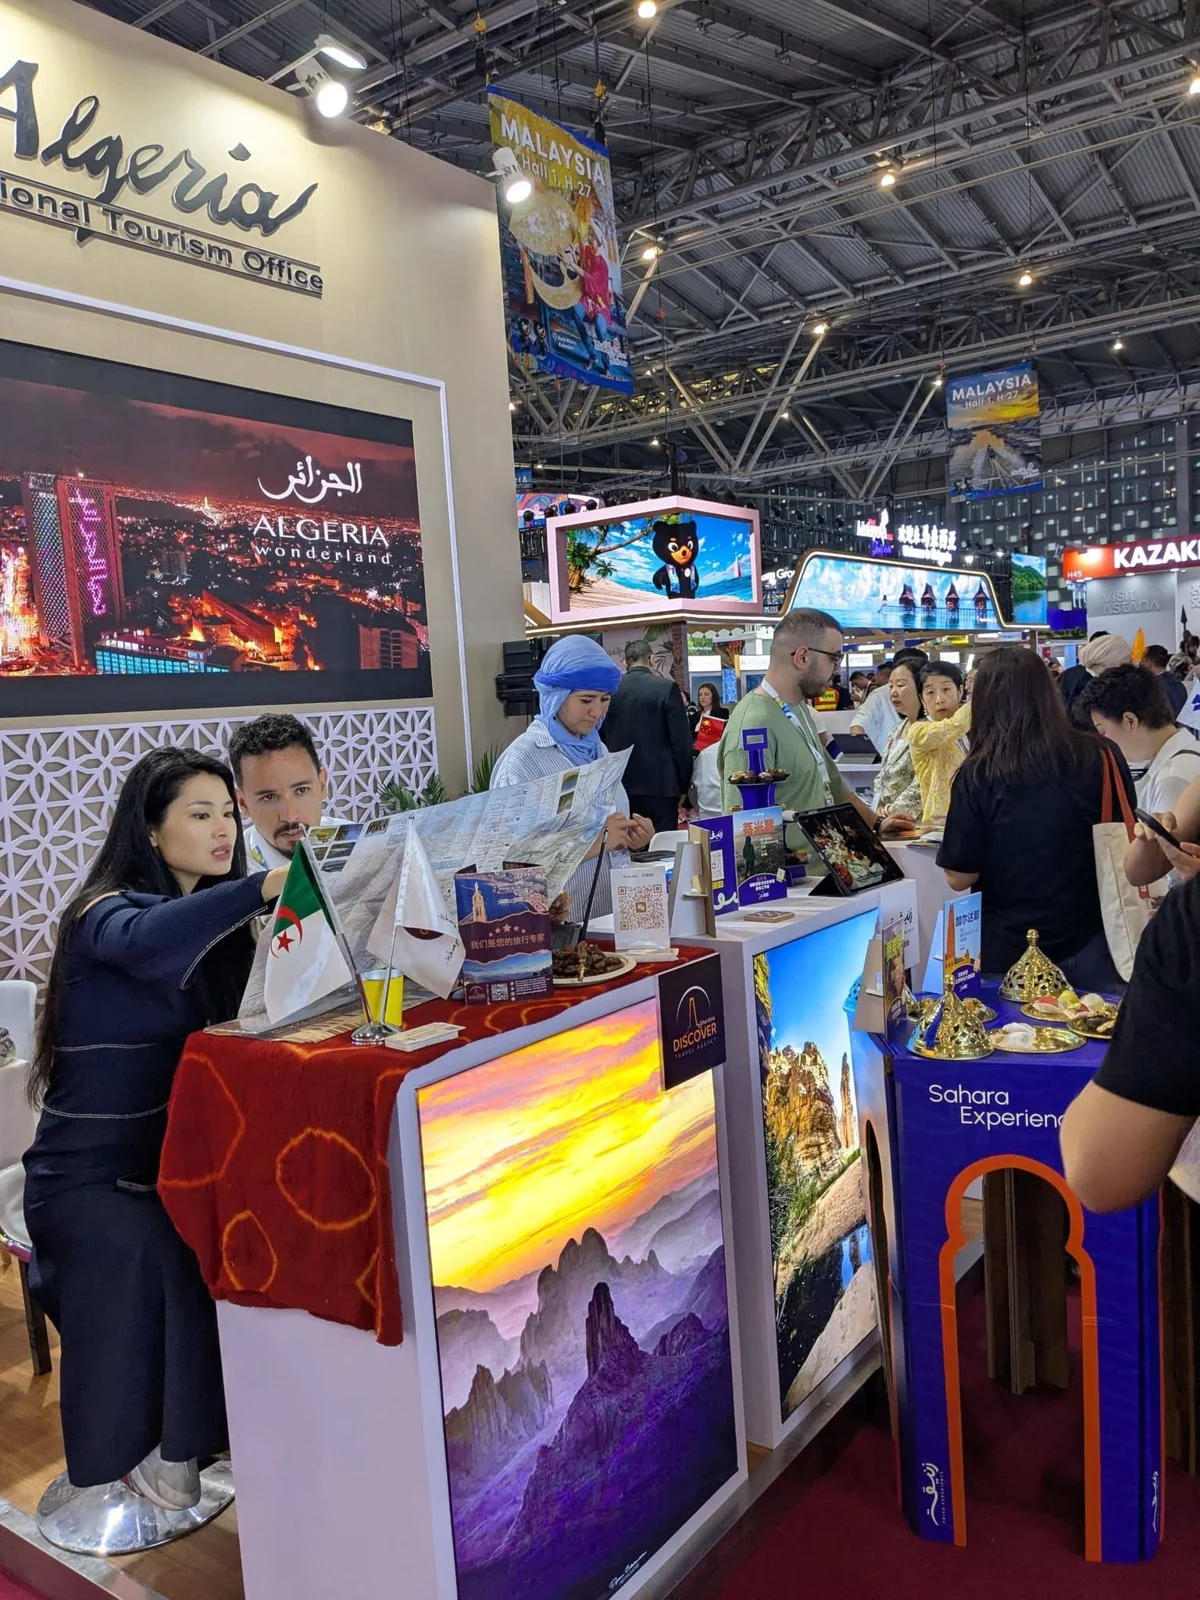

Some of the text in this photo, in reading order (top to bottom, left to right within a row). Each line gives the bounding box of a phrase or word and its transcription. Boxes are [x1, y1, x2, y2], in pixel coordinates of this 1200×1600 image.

[0, 60, 318, 246] Algeria
[500, 113, 605, 186] MALAYSIA
[522, 154, 548, 179] Hall
[578, 181, 591, 198] 27
[0, 176, 323, 289] ional Tourism Office
[952, 374, 1031, 401] MALAYSIA
[965, 399, 984, 409] Hall
[1006, 390, 1019, 400] 27
[257, 455, 362, 503] الجزائر
[253, 514, 389, 547] ALGERIA
[255, 546, 391, 565] wonderland
[1113, 539, 1200, 569] KAZAK
[1067, 570, 1083, 578] H45
[1102, 589, 1137, 602] VISIT
[470, 933, 546, 950] 我们是您的旅行专家
[673, 1023, 717, 1052] DISCOVER
[928, 1084, 1010, 1105] Sahara
